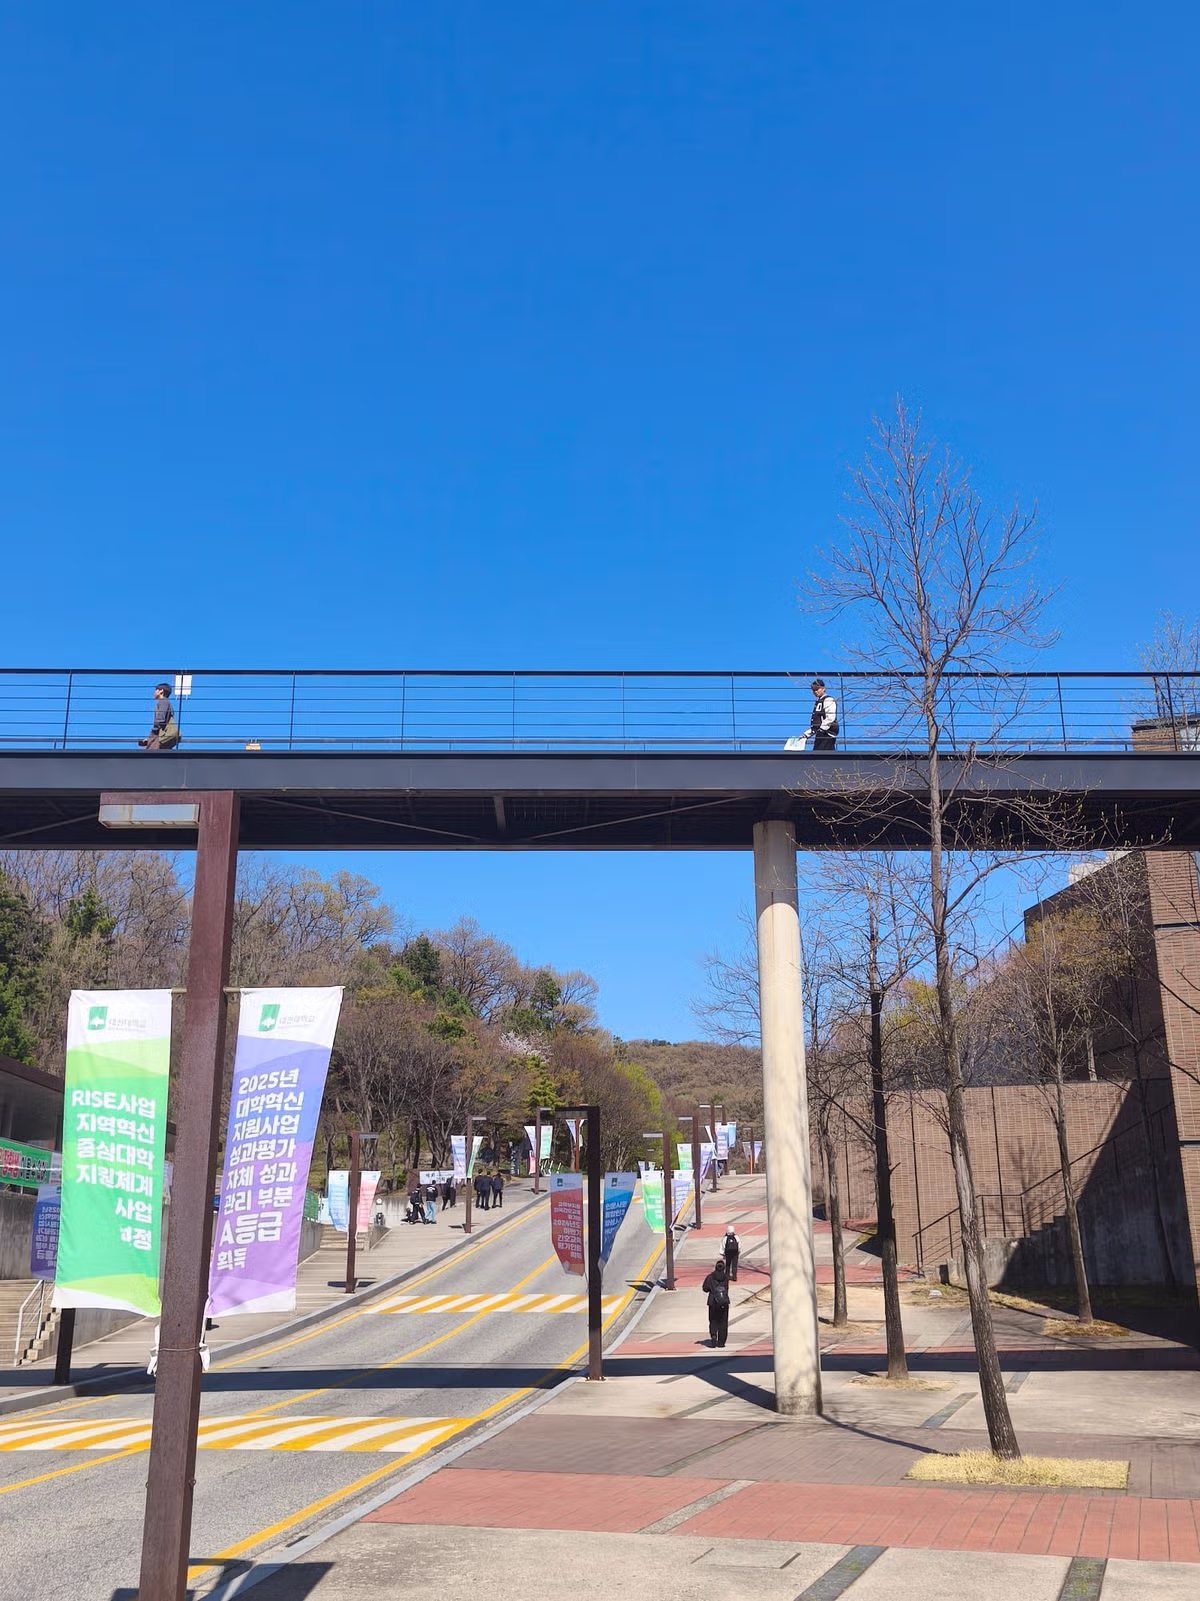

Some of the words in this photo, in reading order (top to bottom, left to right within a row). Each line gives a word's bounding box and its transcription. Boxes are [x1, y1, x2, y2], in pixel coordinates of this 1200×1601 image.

[238, 1067, 300, 1095] 2025년
[71, 1089, 156, 1119] RISE사업
[235, 1091, 304, 1119] 대학혁신
[76, 1113, 155, 1144] 지역혁신
[231, 1113, 301, 1143] 지원사업
[76, 1137, 155, 1171] 중심대학
[229, 1137, 297, 1167] 성과평가
[75, 1163, 153, 1197] 지원체계
[225, 1165, 255, 1191] 자체
[259, 1161, 298, 1185] 성과
[114, 1197, 152, 1224] 사업
[223, 1189, 252, 1216] 관리
[257, 1186, 294, 1209] 부분
[219, 1211, 283, 1248] A등급
[216, 1247, 247, 1271] 획득
